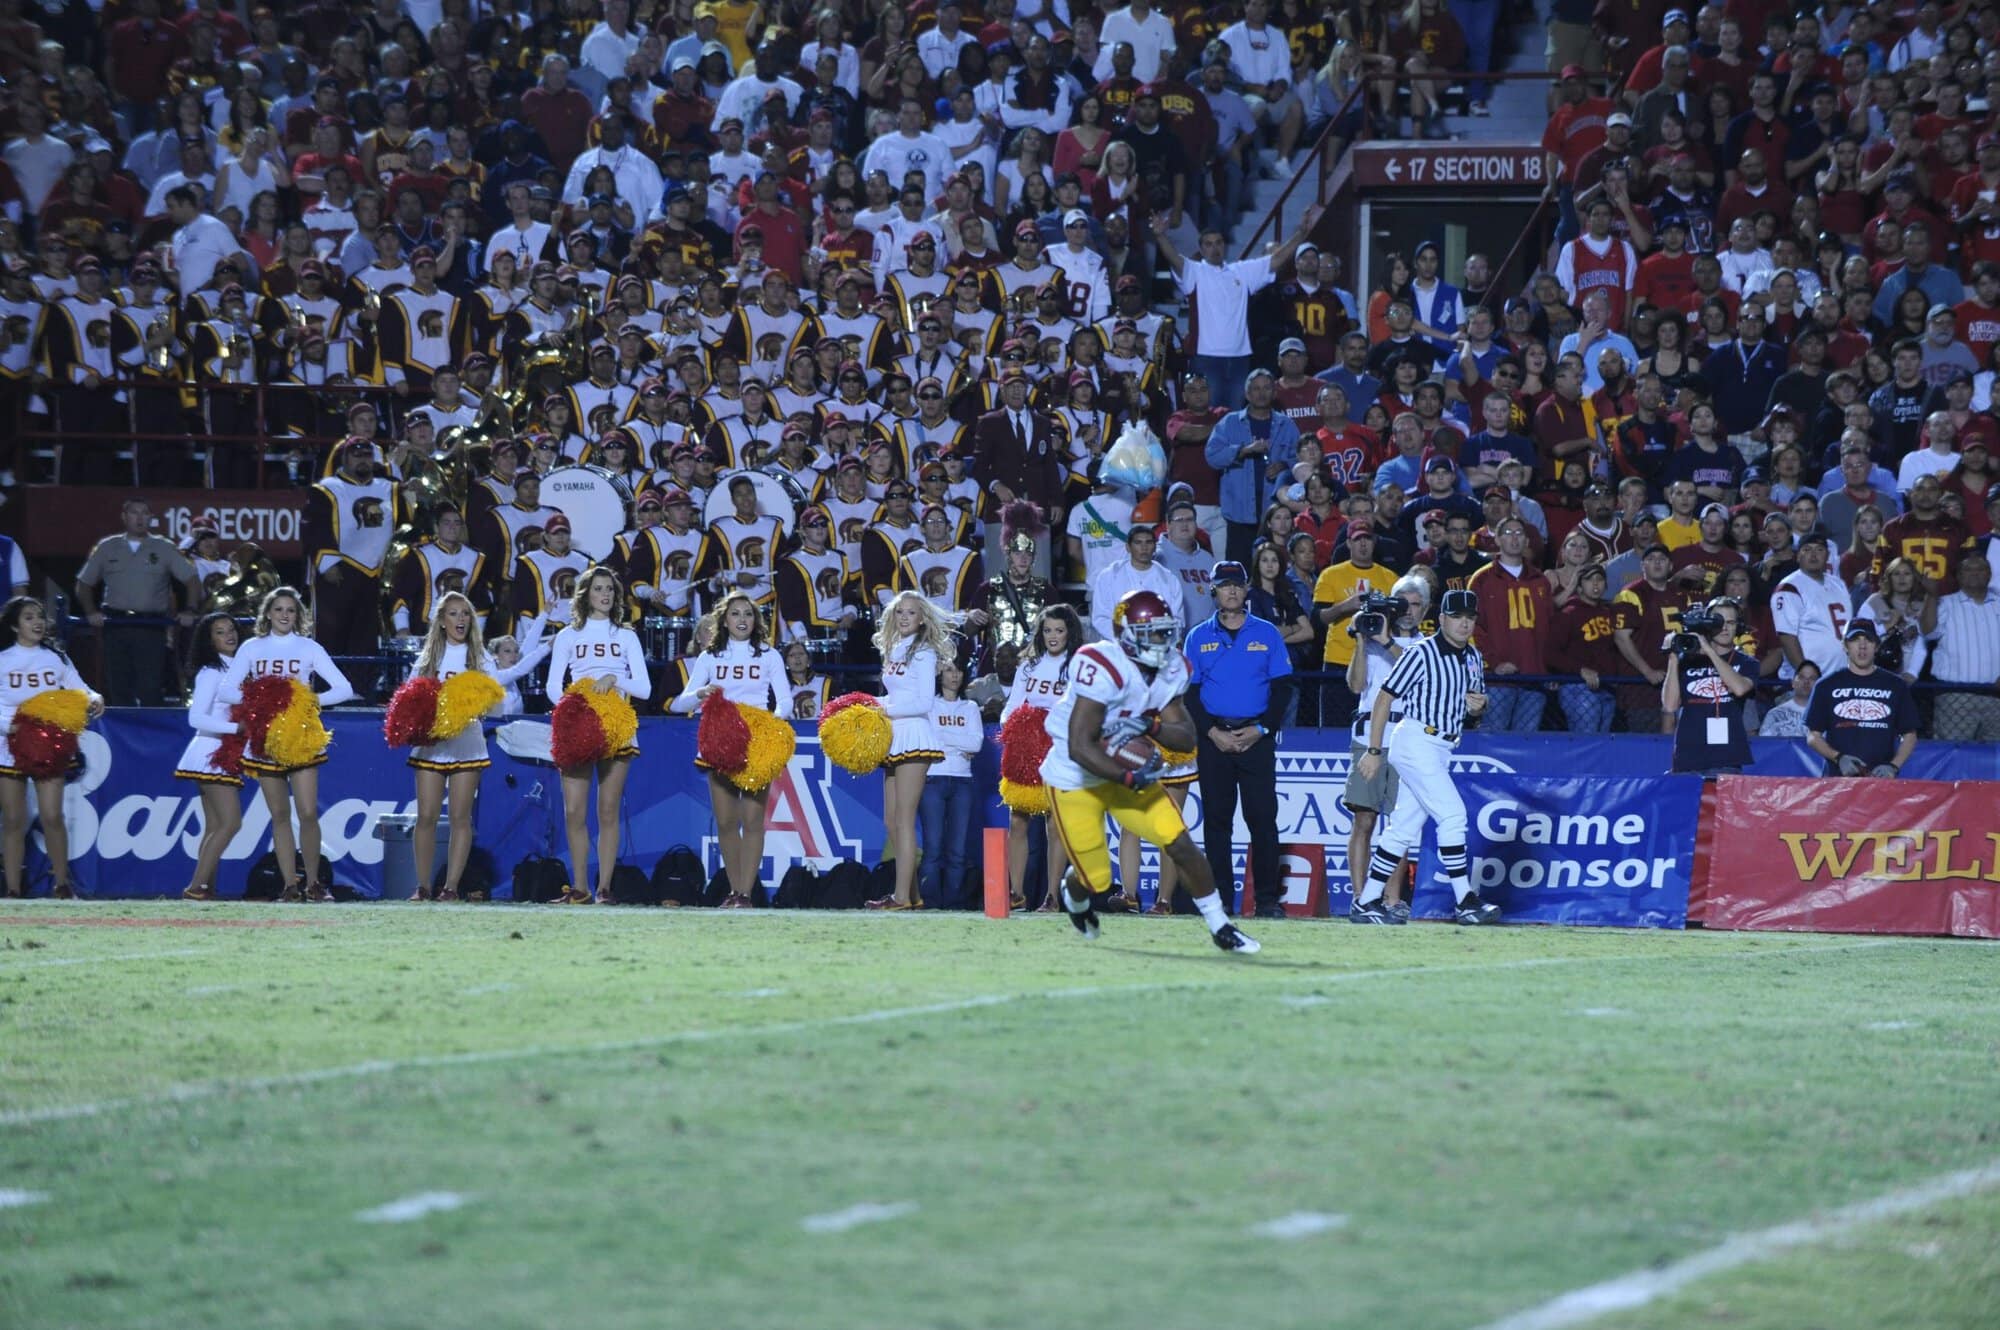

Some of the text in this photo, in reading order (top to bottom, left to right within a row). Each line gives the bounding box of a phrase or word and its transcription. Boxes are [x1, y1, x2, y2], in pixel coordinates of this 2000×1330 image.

[1161, 94, 1194, 113] USC
[1408, 156, 1541, 181] 17 SECTION 18
[1323, 446, 1368, 484] 32
[563, 481, 595, 491] YAMAHA
[165, 506, 193, 540] 16
[1902, 537, 1949, 580] 55
[1180, 568, 1211, 584] USC
[1508, 586, 1536, 630] 10
[575, 643, 622, 659] USC
[256, 659, 301, 676] USC
[715, 664, 761, 681] USC
[1076, 660, 1097, 687] 13
[9, 671, 56, 689] USC
[1026, 676, 1067, 696] USC
[1832, 687, 1892, 699] CAT VISION
[1476, 799, 1646, 845] Game
